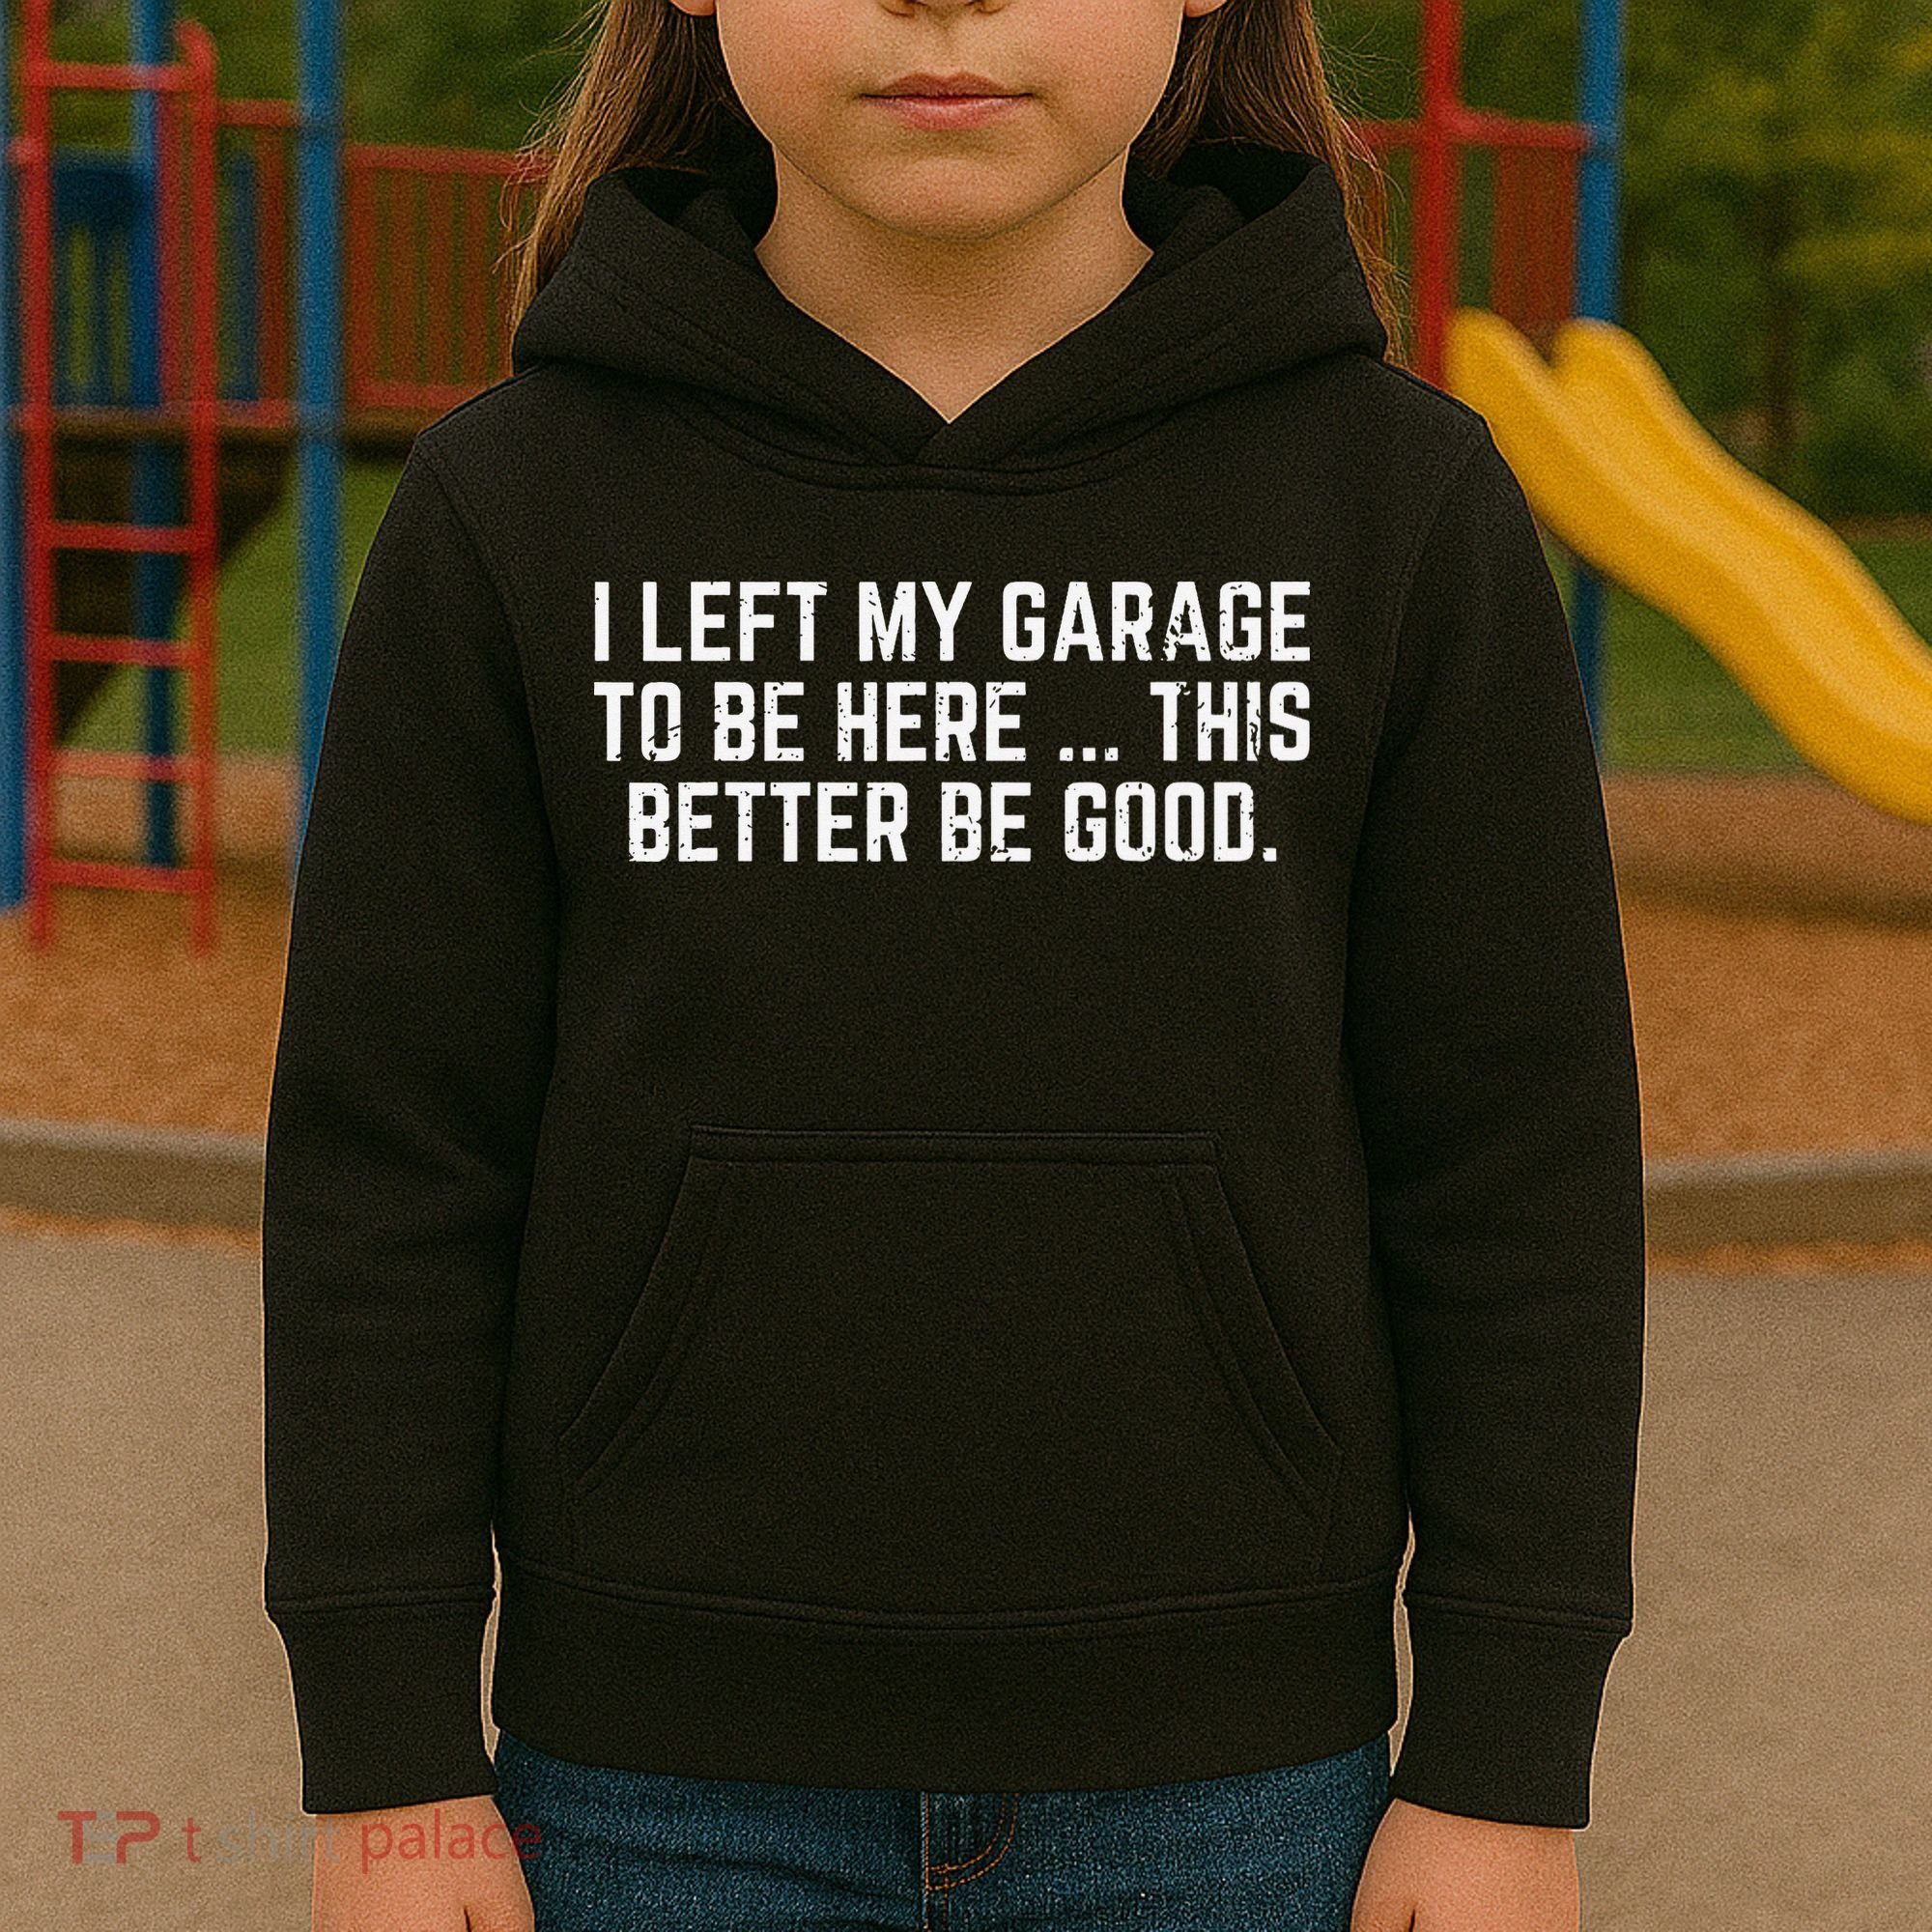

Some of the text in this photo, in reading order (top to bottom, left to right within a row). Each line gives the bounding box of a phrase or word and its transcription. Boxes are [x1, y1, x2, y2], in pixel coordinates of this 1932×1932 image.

[594, 581, 1311, 662] I LEFT MY GARAGE
[593, 681, 681, 762] TO
[713, 681, 805, 762] BE
[837, 681, 1027, 762] HERE
[1150, 681, 1311, 762] THIS
[628, 781, 1277, 863] BETTER BE GOOD.
